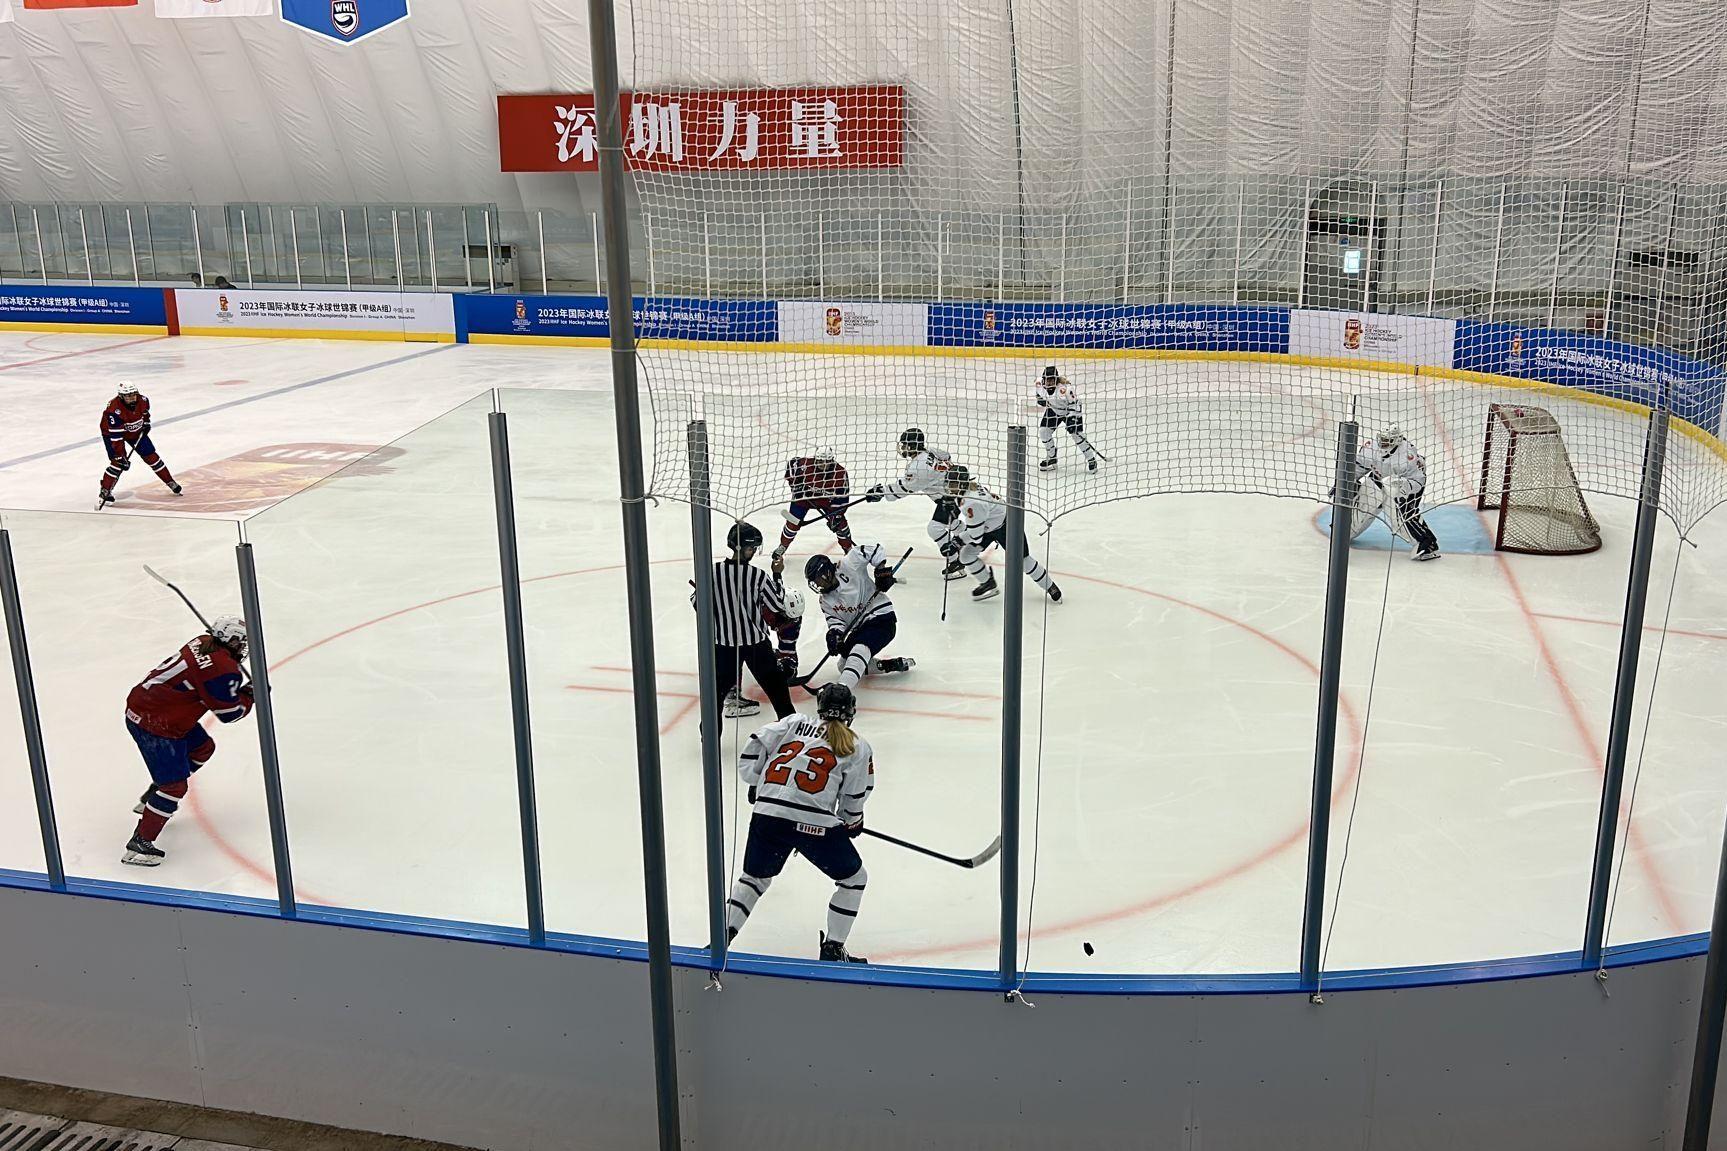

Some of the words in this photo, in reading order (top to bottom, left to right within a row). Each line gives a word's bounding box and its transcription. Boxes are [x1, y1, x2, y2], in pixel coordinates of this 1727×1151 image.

[334, 2, 355, 12] WHL
[553, 99, 843, 162] 深圳力量
[840, 573, 849, 583] C
[828, 708, 840, 717] 23
[763, 740, 838, 794] 23
